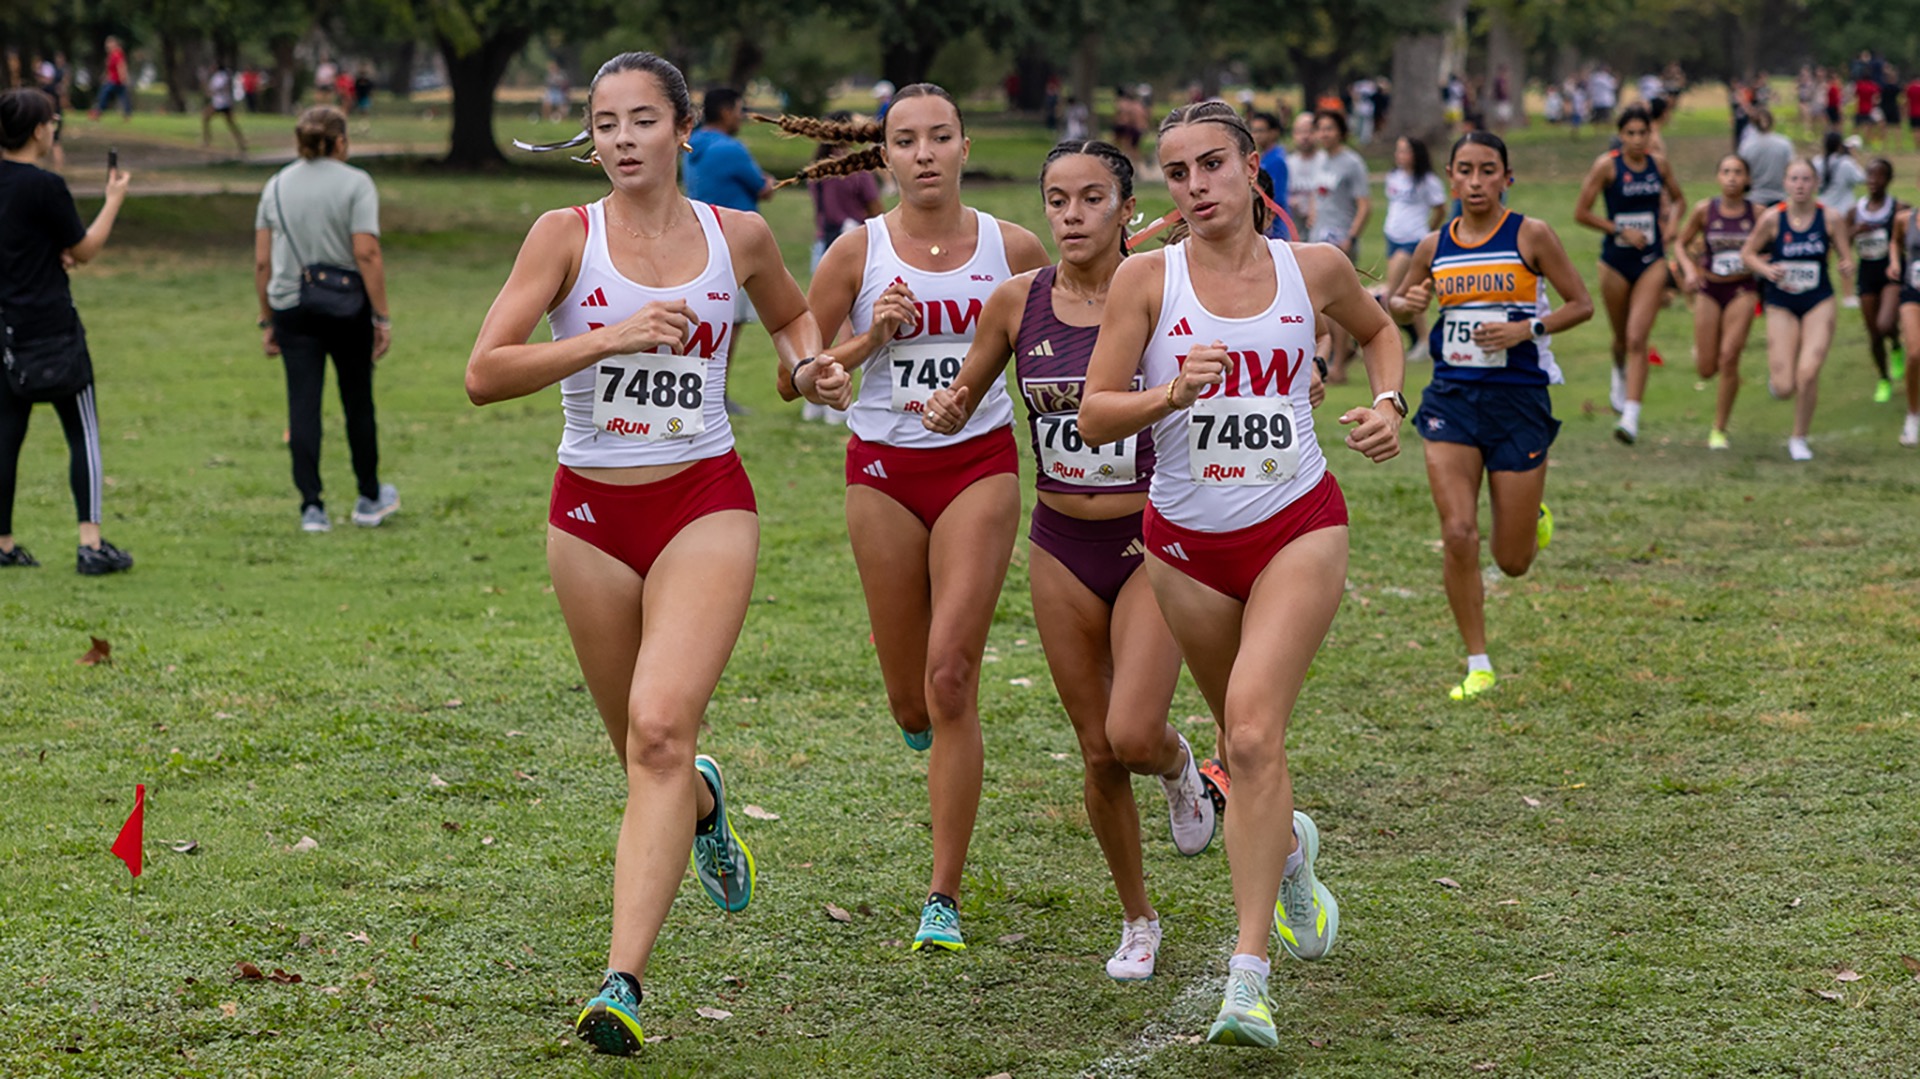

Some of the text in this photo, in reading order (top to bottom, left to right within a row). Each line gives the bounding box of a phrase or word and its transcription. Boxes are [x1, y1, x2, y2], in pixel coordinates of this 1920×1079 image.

[1437, 272, 1516, 297] CORPIONS
[894, 357, 966, 389] 749
[600, 366, 703, 409] 7488
[606, 417, 650, 436] iRUN
[1192, 413, 1292, 450] 7489
[1053, 461, 1085, 478] iRUN
[1203, 464, 1245, 481] iRUN
